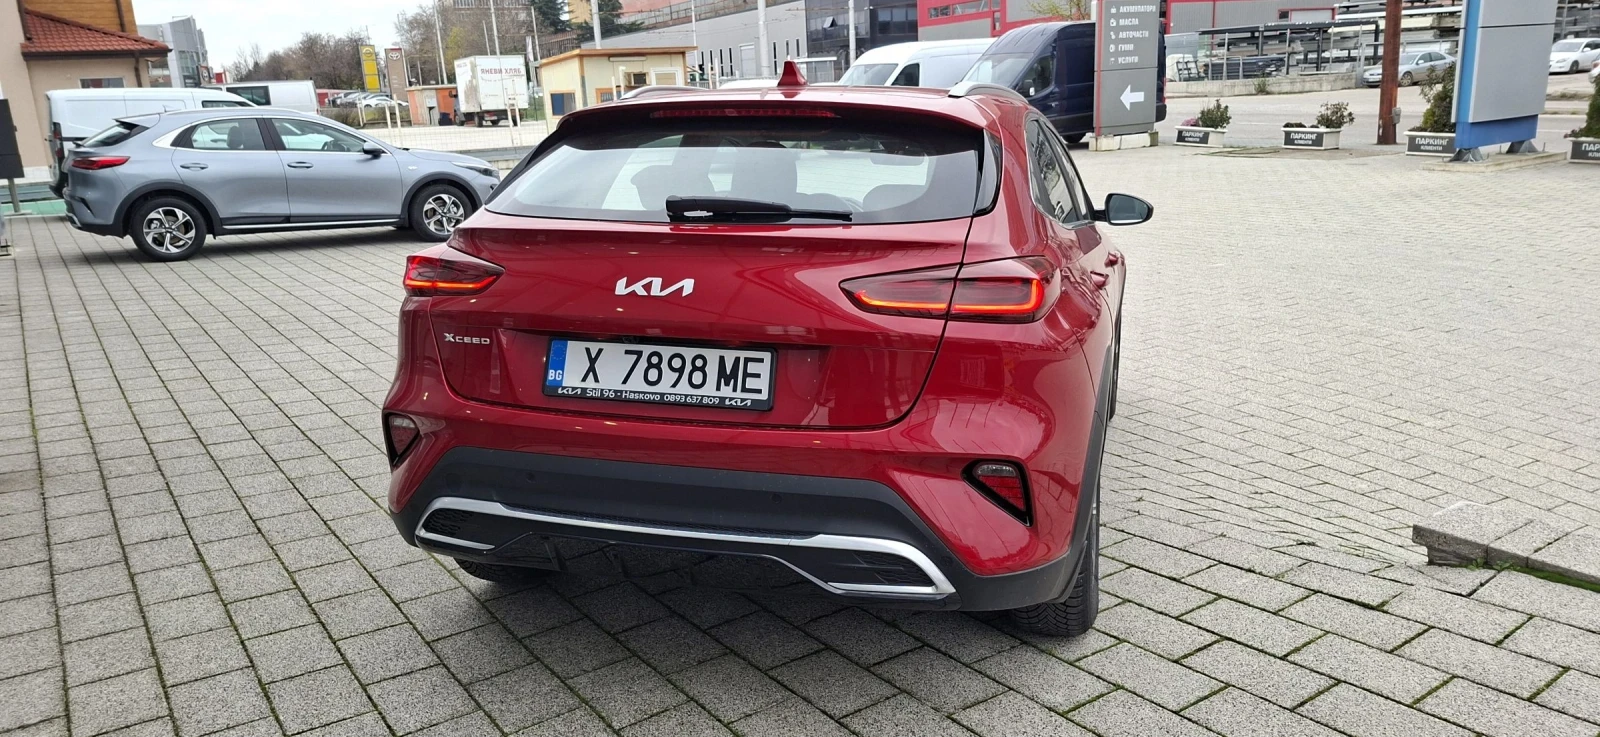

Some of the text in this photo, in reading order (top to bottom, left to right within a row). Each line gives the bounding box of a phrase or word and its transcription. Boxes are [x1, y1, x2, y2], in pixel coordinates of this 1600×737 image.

[615, 276, 695, 297] KIA
[548, 369, 562, 381] BG
[580, 347, 765, 395] X 7898 ME
[586, 388, 601, 398] Stil
[602, 389, 615, 398] 96
[622, 390, 660, 401] Haskovo
[664, 394, 685, 403] 0893
[686, 395, 702, 404] 637
[702, 396, 719, 405] 809
